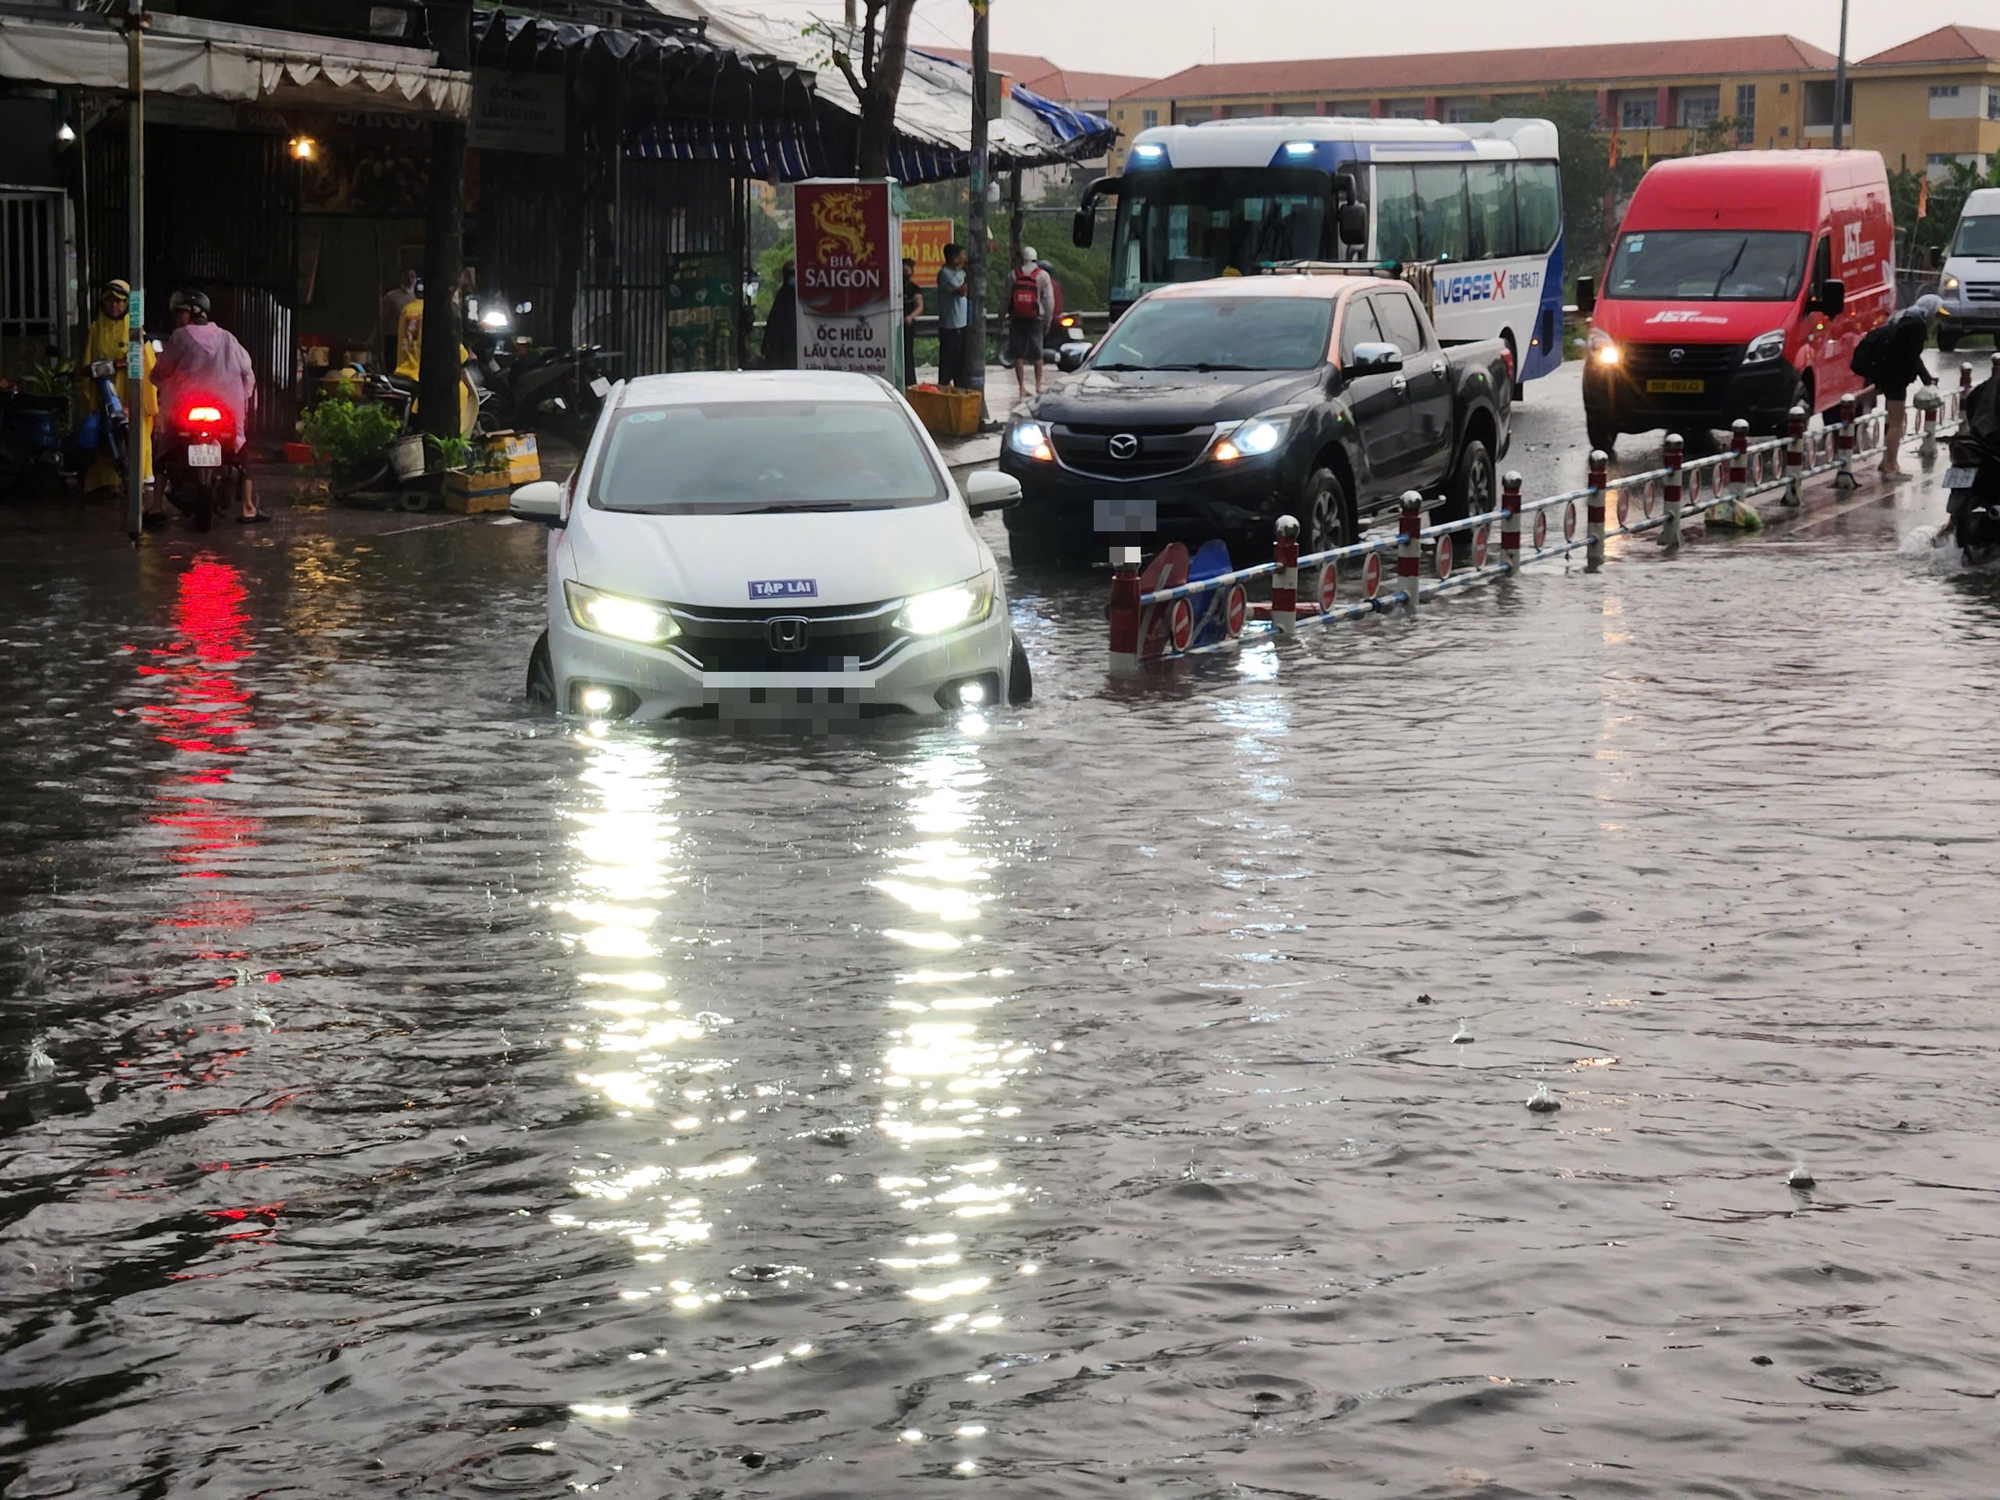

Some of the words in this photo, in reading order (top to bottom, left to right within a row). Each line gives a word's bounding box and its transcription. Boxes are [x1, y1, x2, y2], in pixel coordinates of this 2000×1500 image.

[830, 256, 853, 267] BIA
[805, 269, 880, 288] SAIGON
[817, 323, 837, 341] ỐC
[830, 344, 855, 359] CÁC
[858, 346, 886, 362] LOẠI
